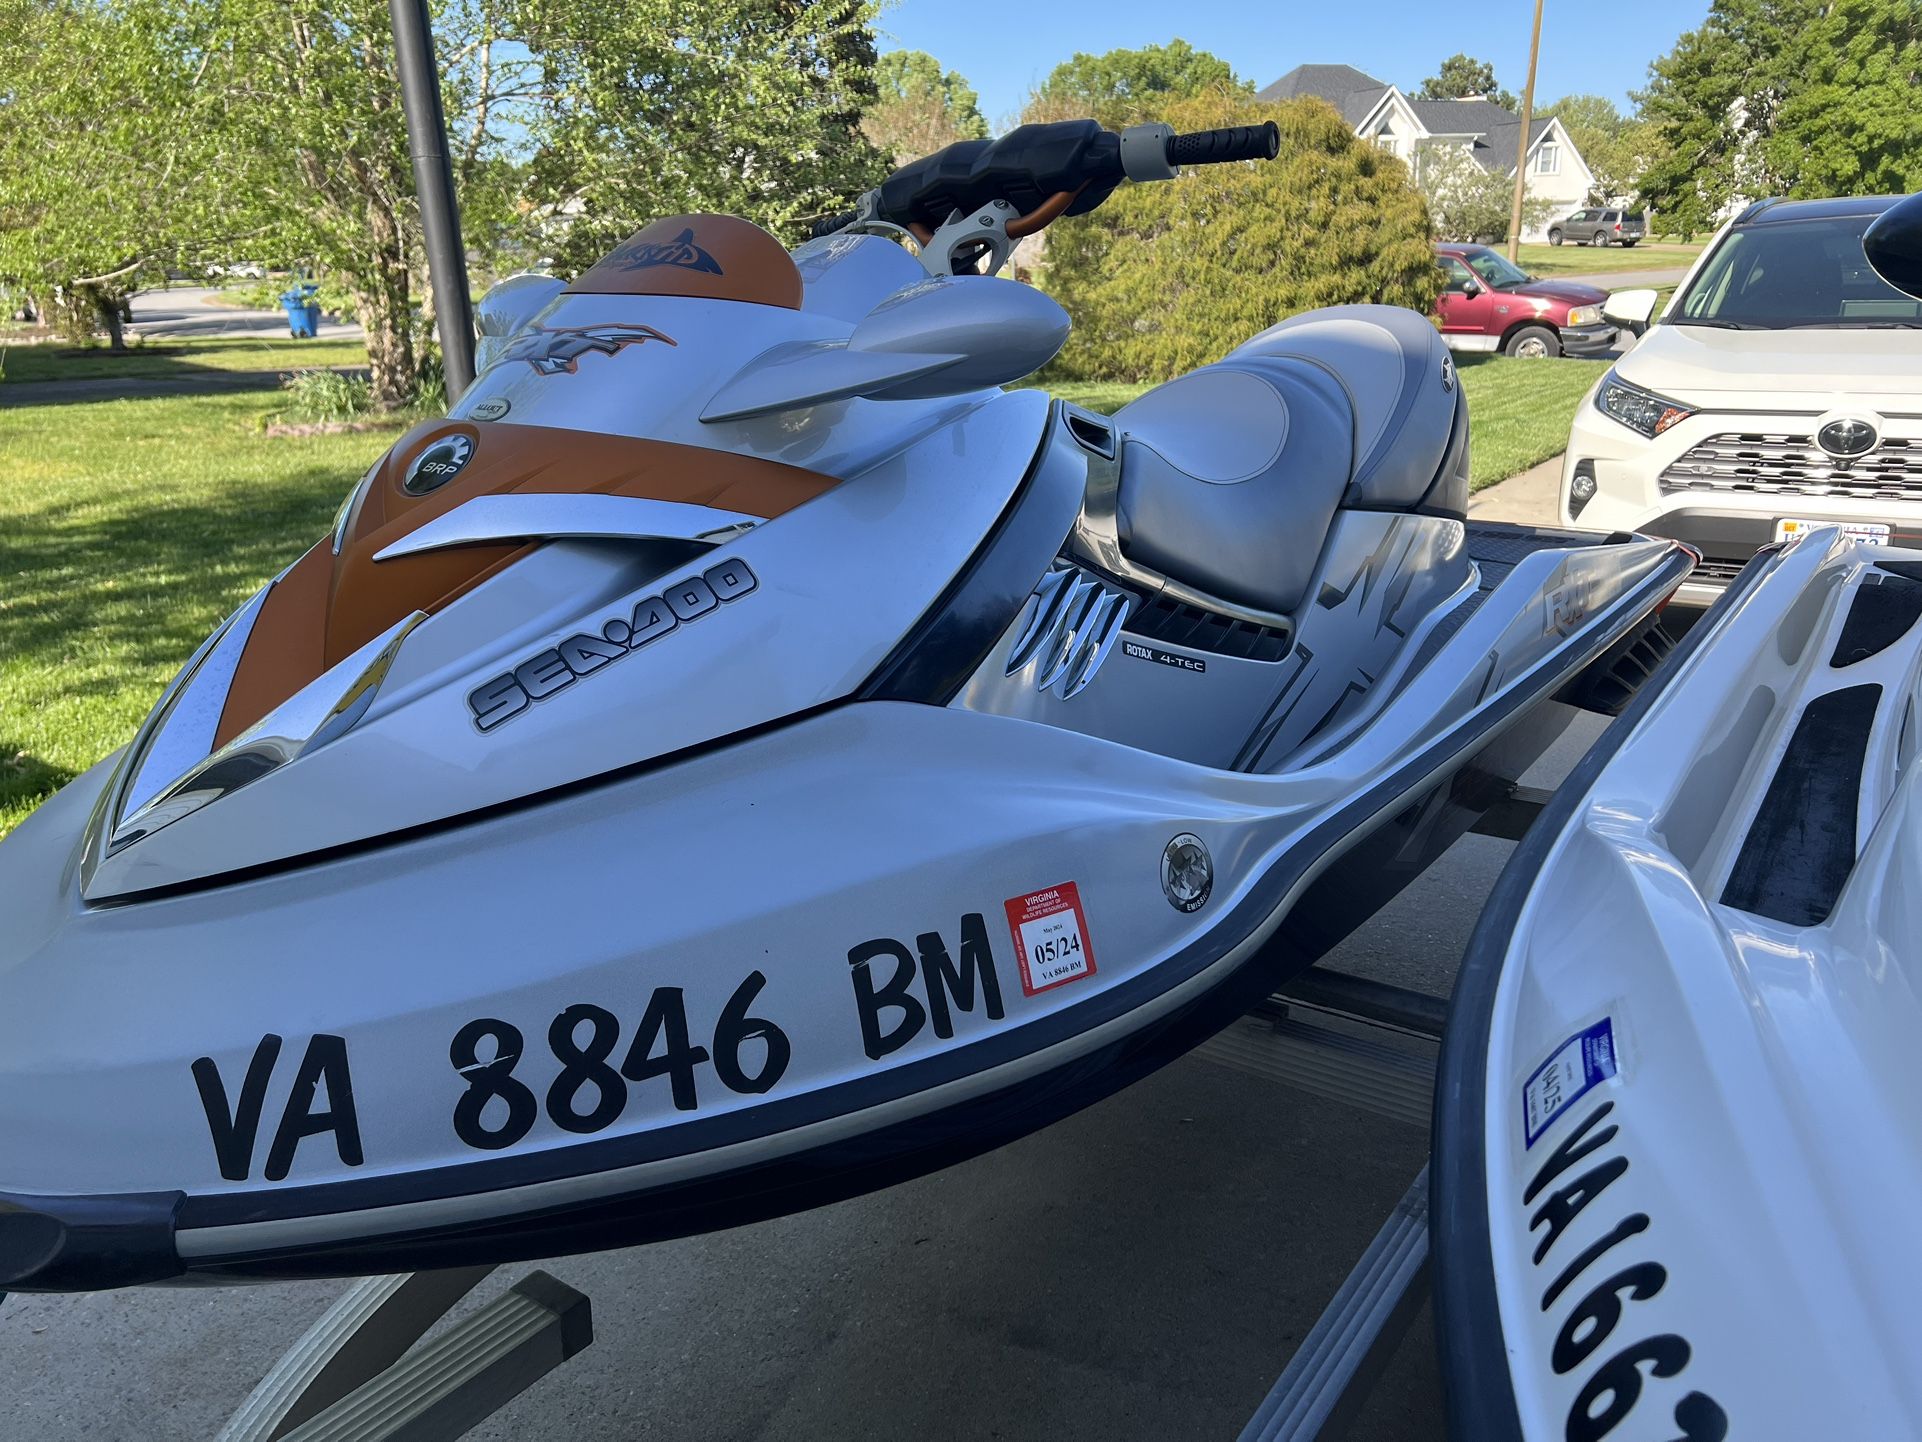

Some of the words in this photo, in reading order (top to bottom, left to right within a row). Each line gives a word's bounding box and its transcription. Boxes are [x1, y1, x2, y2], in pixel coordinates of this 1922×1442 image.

[422, 461, 458, 475] BRP
[1126, 643, 1153, 661] ROTAX
[1160, 654, 1205, 672] 4-TEC
[1024, 889, 1060, 907] VIRGINIA
[1034, 933, 1080, 964] 05/24
[1042, 969, 1054, 980] VA
[1054, 966, 1070, 978] 8846
[1070, 960, 1082, 971] BM
[191, 1034, 364, 1181] VA
[450, 970, 790, 1150] 8846
[848, 913, 1005, 1060] BM
[1542, 1063, 1562, 1114] 04/25
